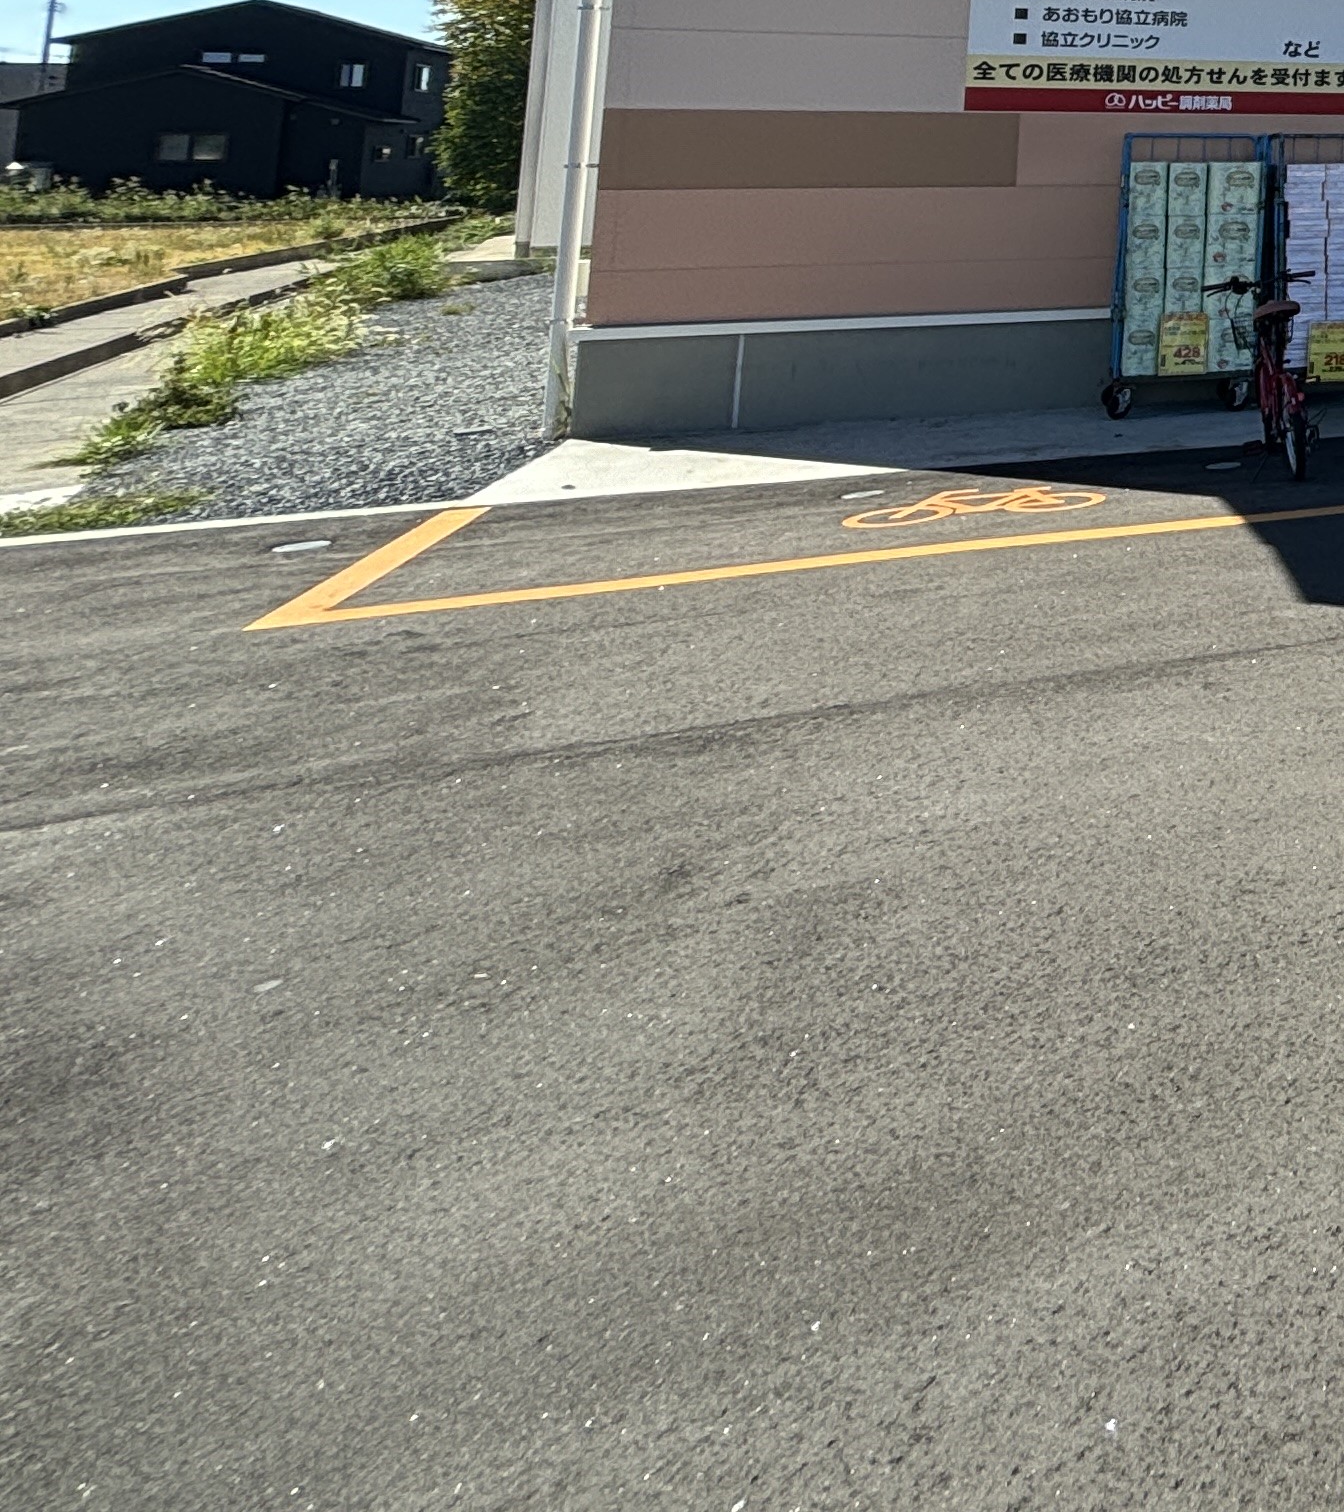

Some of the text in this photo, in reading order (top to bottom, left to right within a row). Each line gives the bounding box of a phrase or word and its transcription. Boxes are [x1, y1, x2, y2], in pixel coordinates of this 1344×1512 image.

[1042, 6, 1189, 28] あおもり協立病院
[1041, 31, 1160, 50] 協立クリニック
[1282, 40, 1321, 59] など
